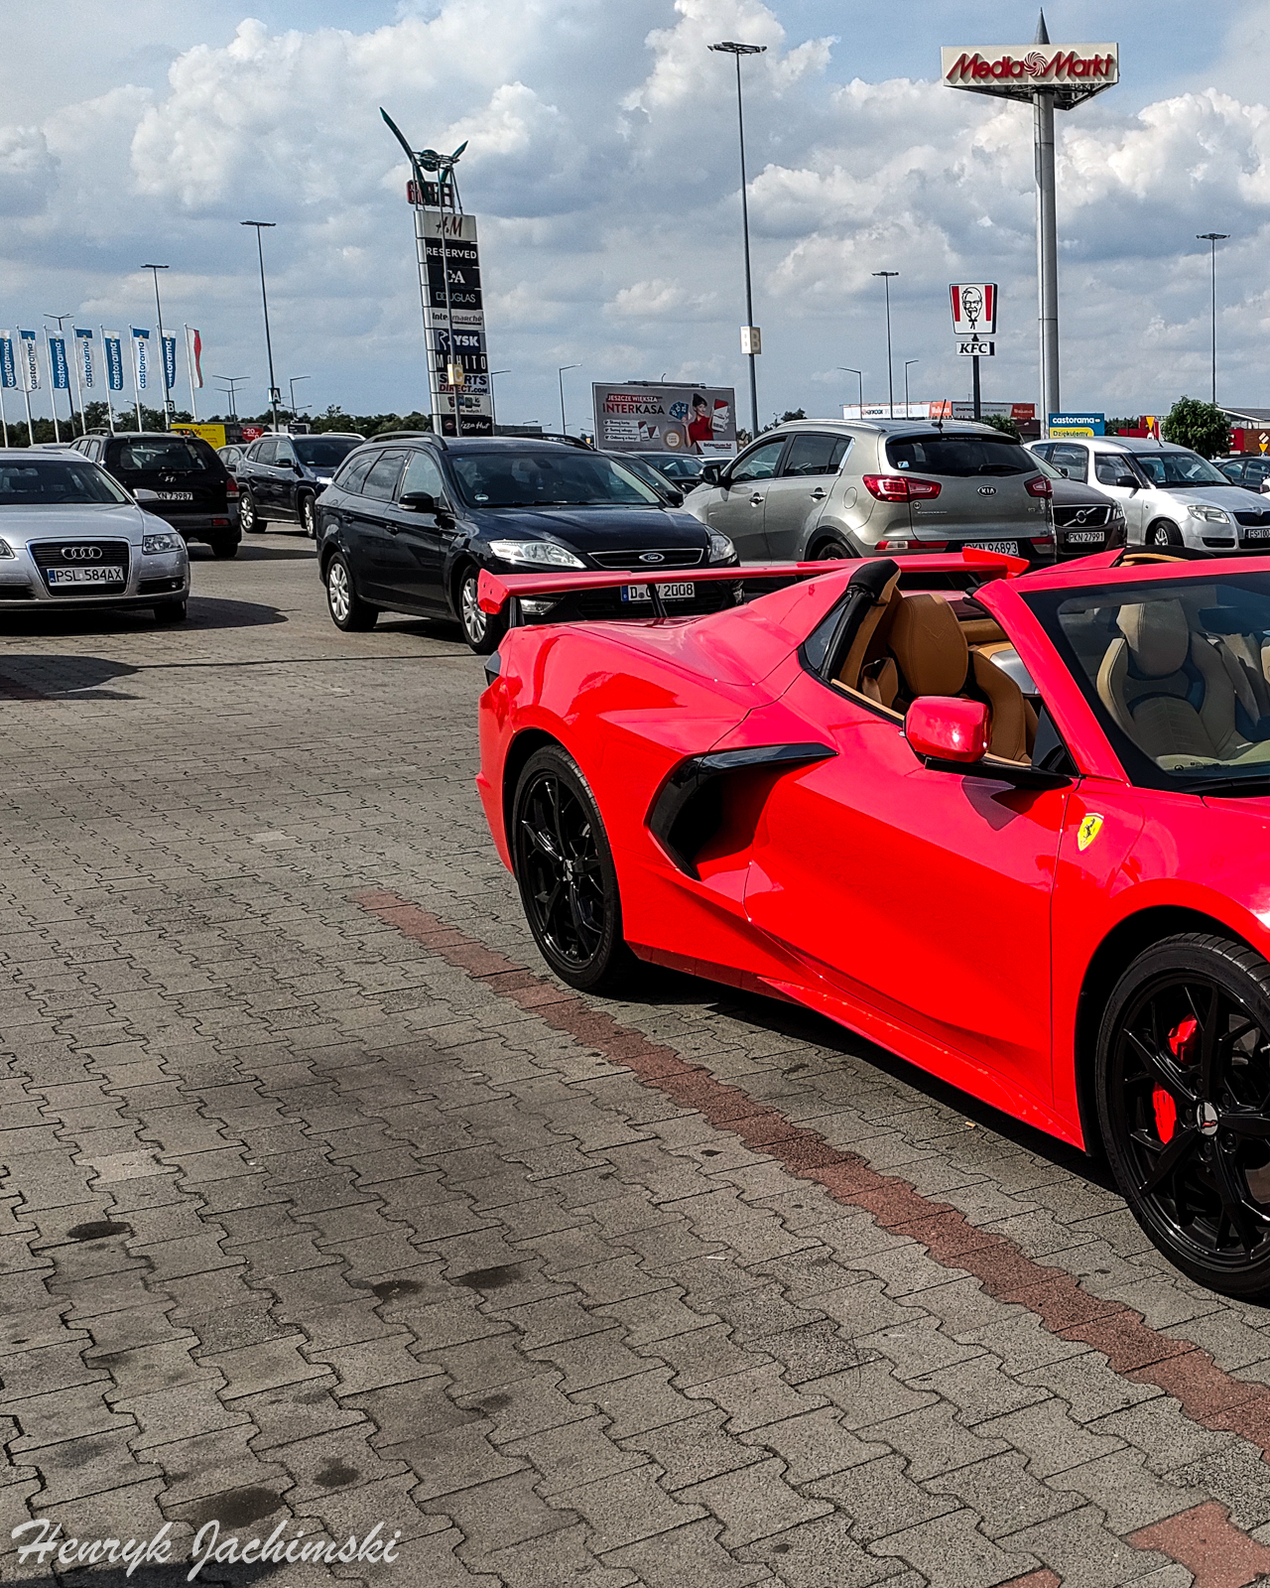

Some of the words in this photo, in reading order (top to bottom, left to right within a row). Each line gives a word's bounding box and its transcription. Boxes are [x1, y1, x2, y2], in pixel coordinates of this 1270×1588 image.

[947, 53, 1025, 79] Media
[1041, 51, 1113, 78] Markt
[426, 246, 477, 259] RESERVED
[435, 291, 476, 303] DOUGLAS
[432, 312, 483, 322] Intemarché
[448, 335, 479, 347] YSK
[751, 330, 760, 351] B
[959, 343, 987, 354] KFC
[55, 342, 65, 388] castorama
[83, 341, 93, 388] castorama
[110, 342, 121, 389] castorama
[138, 341, 147, 389] castorama
[440, 373, 487, 385] SRTS
[273, 389, 281, 402] A
[168, 402, 175, 413] B
[603, 403, 665, 415] INTERKASA
[1052, 416, 1095, 424] castorama
[56, 572, 81, 582] PSL
[84, 569, 122, 581] 584AX
[630, 586, 638, 599] D
[663, 584, 694, 597] 2008
